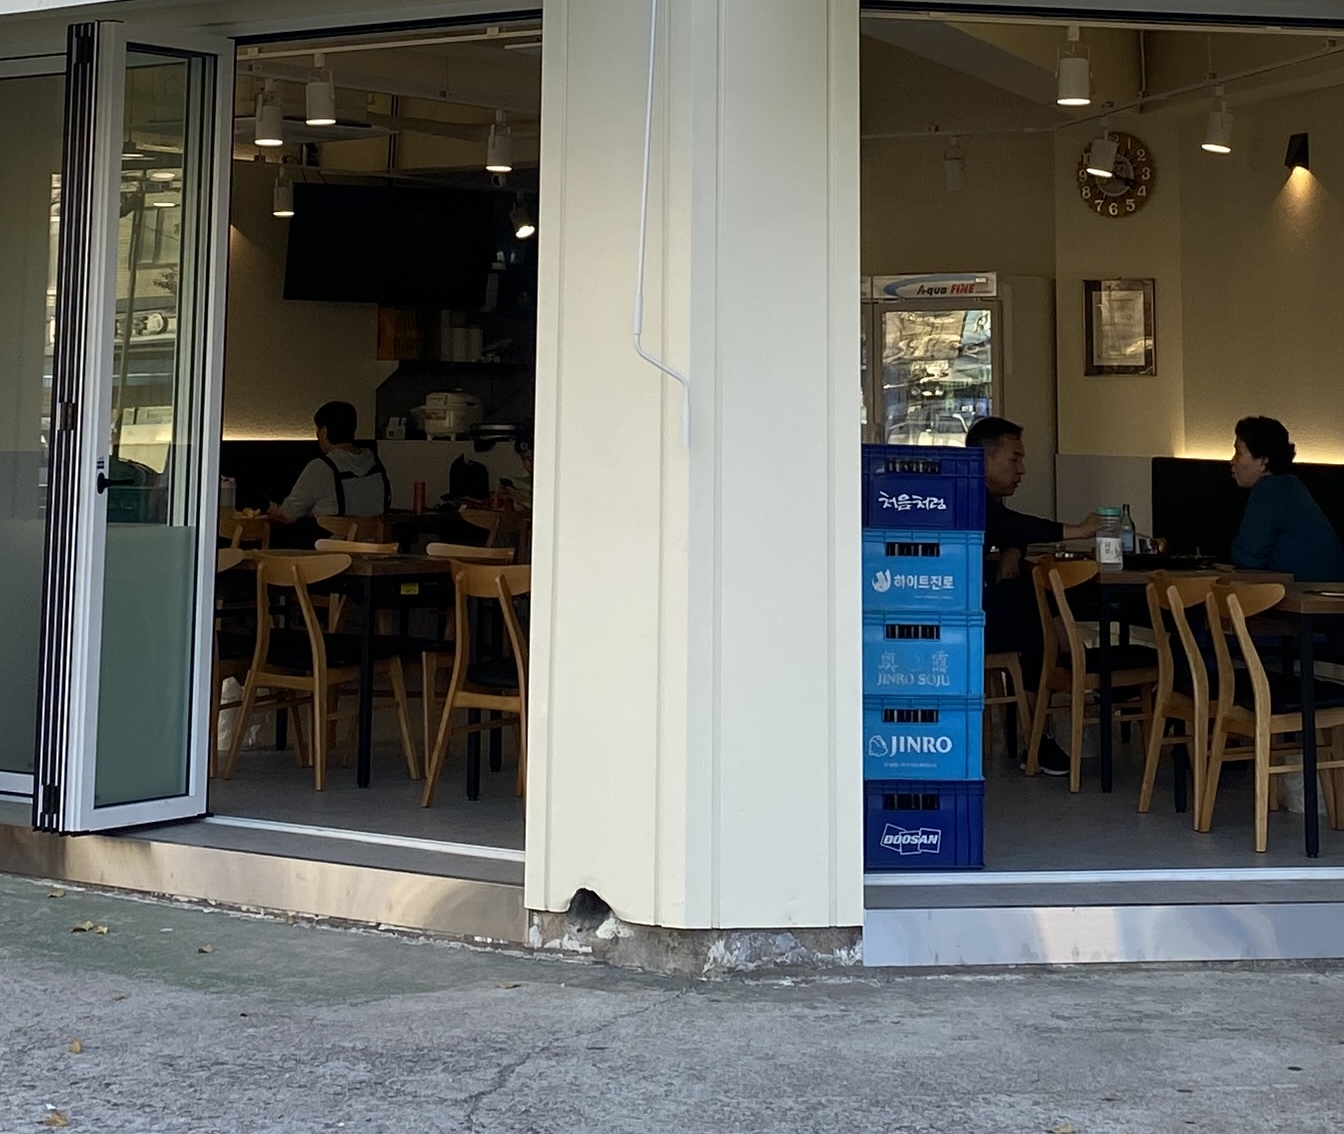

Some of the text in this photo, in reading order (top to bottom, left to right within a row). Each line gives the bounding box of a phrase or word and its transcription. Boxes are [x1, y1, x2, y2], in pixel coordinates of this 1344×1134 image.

[916, 282, 976, 296] Aqua FINE
[893, 574, 955, 591] 하이트진로
[877, 672, 951, 687] JINRO SOJU
[890, 735, 953, 757] JINRO
[883, 834, 939, 845] DOOSAN
